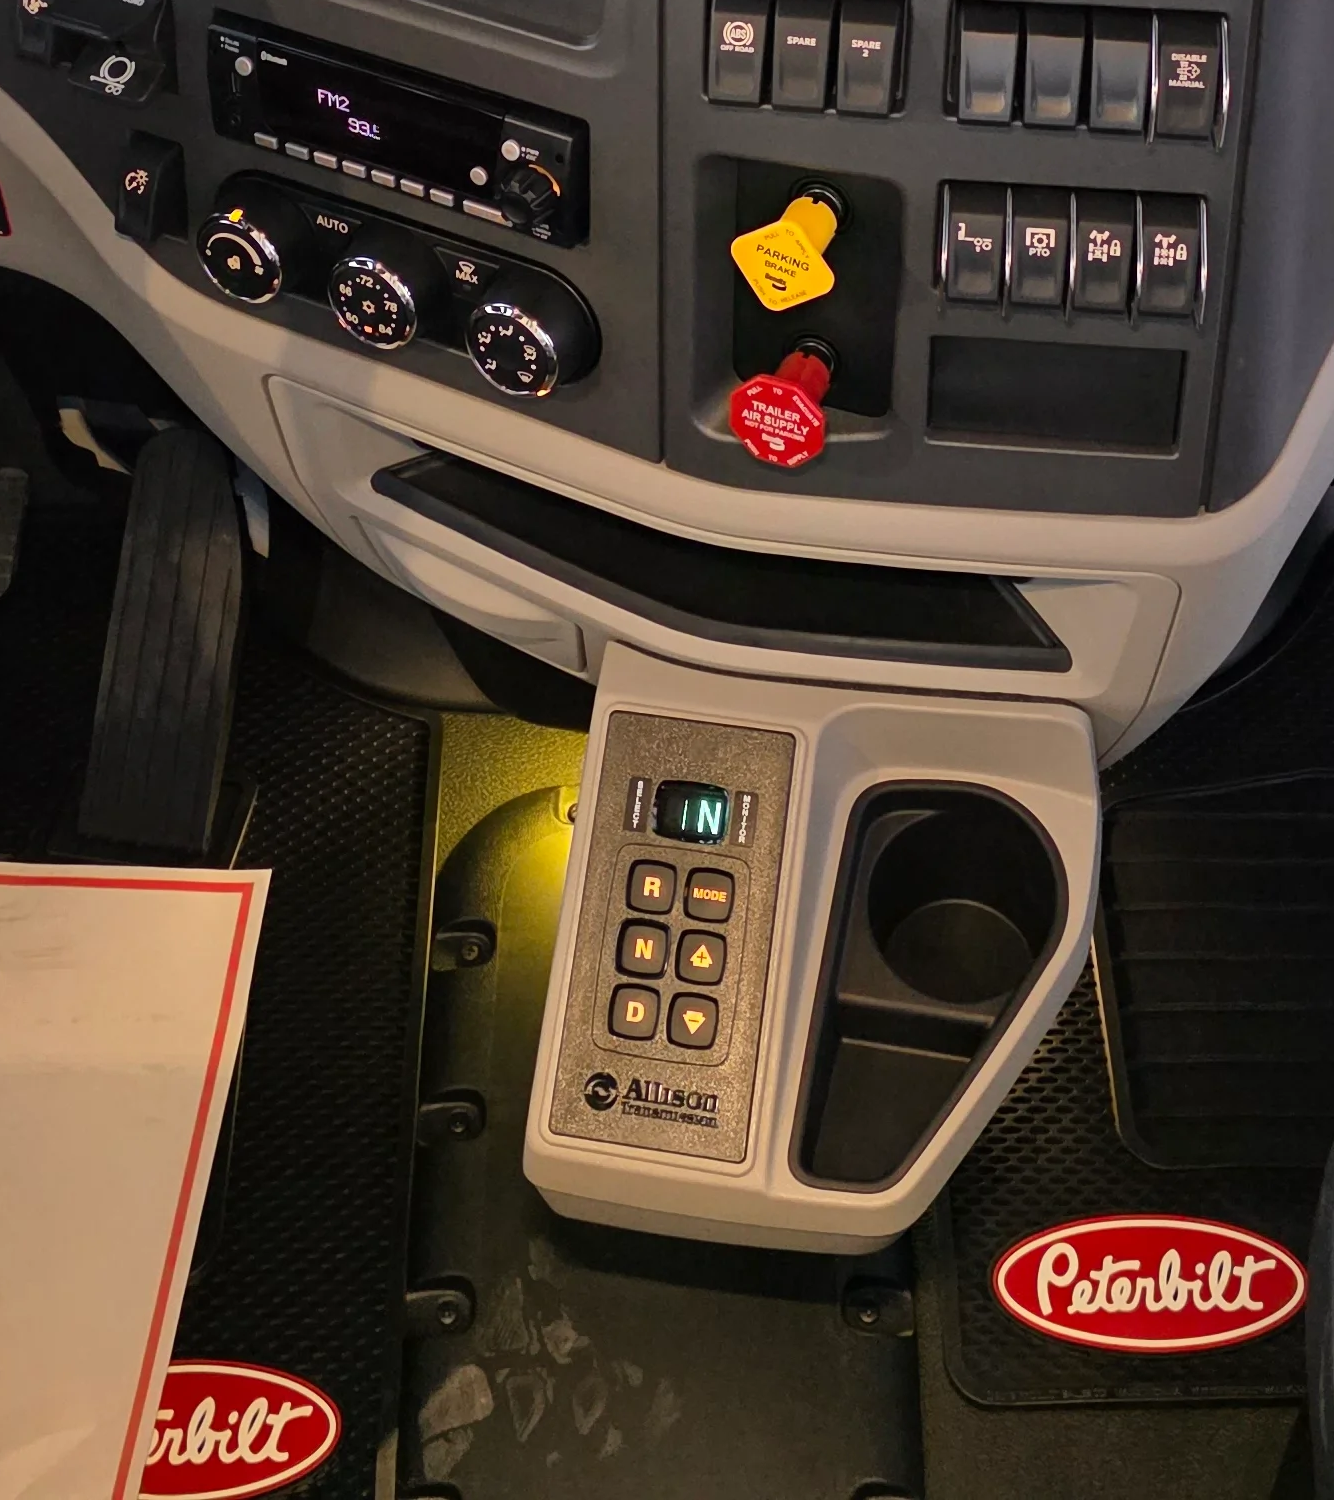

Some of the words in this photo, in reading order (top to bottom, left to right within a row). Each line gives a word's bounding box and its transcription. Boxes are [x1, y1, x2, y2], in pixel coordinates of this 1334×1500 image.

[730, 28, 747, 40] ABS
[786, 35, 817, 47] SPARE
[735, 46, 755, 54] ROAD
[851, 39, 882, 50] SPARE
[861, 49, 869, 57] 2
[1171, 52, 1207, 63] DISABLE
[1168, 79, 1205, 88] MANUAL
[317, 88, 350, 113] FM2
[316, 214, 349, 234] AUTO
[785, 228, 794, 237] TO
[756, 244, 810, 271] PARKING
[1028, 247, 1051, 257] PTO
[455, 269, 479, 285] MAX
[764, 259, 797, 278] BRAKE
[359, 274, 374, 288] 72
[780, 289, 808, 303] RELEASE
[383, 300, 398, 313] 78
[345, 311, 359, 324] 60
[751, 400, 801, 423] TRAILER
[772, 386, 783, 396] TO
[792, 394, 820, 428] EVACUATE
[741, 408, 762, 422] AIR
[763, 415, 810, 436] SUPPLY
[744, 419, 759, 428] NOT
[759, 423, 774, 433] FOR
[774, 428, 806, 443] PARKING
[768, 453, 778, 462] TO
[632, 780, 644, 829] SELECT
[697, 799, 722, 835] N
[738, 794, 752, 844] MONITOR
[643, 876, 662, 898] R
[692, 887, 727, 903] MODE
[633, 938, 654, 961] N
[625, 1001, 645, 1024] D
[621, 1077, 720, 1113] Allison
[621, 1101, 719, 1128] Transmission
[1036, 1242, 1277, 1316] Peterbilt
